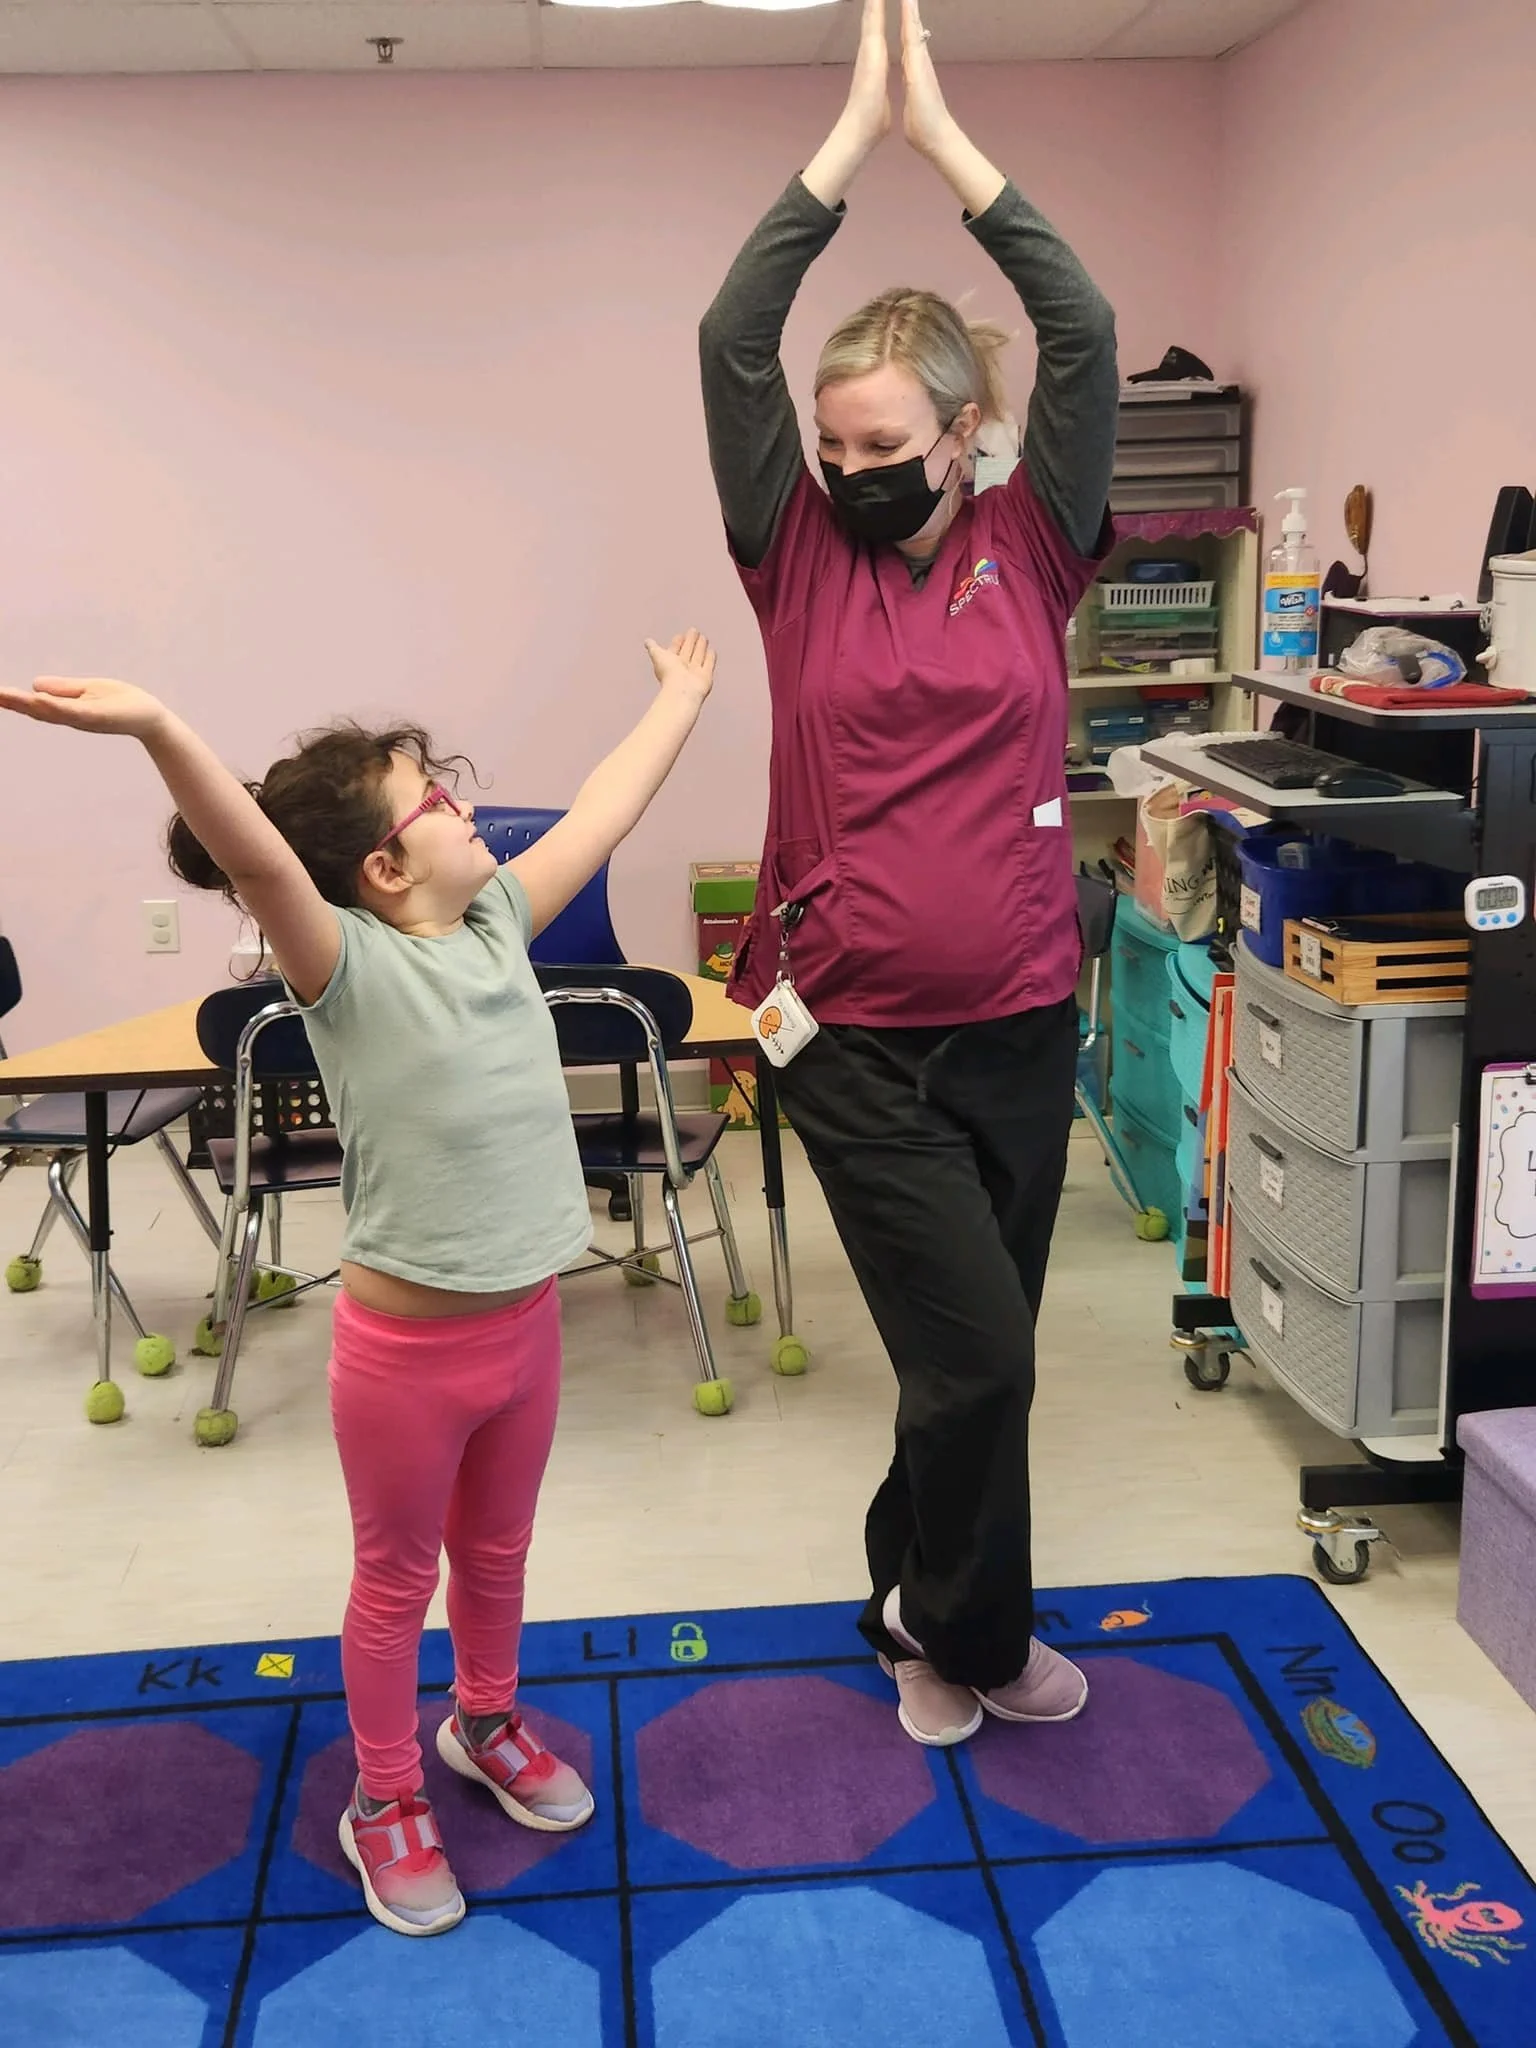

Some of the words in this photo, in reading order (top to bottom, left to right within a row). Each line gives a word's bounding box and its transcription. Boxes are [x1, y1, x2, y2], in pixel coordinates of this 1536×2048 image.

[949, 574, 1000, 617] SPECTRU
[137, 1656, 224, 1694] Kk
[1265, 1644, 1339, 1696] Nn
[1371, 1800, 1446, 1864] Oo
